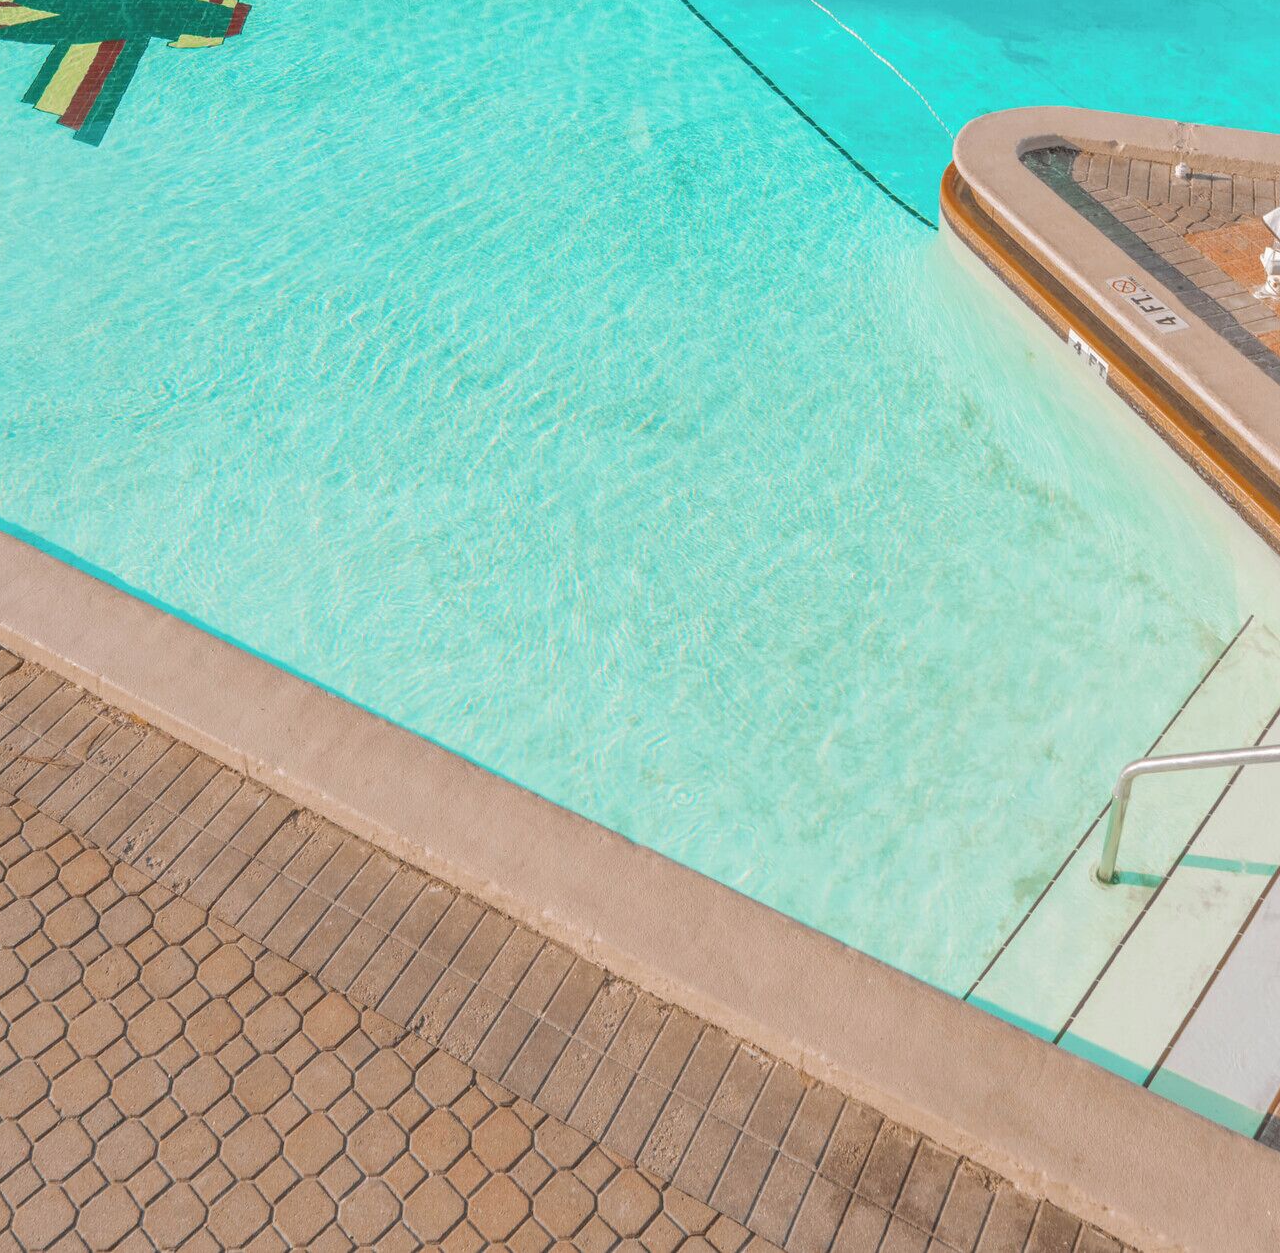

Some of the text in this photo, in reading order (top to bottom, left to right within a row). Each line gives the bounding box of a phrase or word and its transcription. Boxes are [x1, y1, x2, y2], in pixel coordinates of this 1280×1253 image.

[1155, 316, 1177, 325] 4
[1073, 341, 1107, 378] 4 FT
